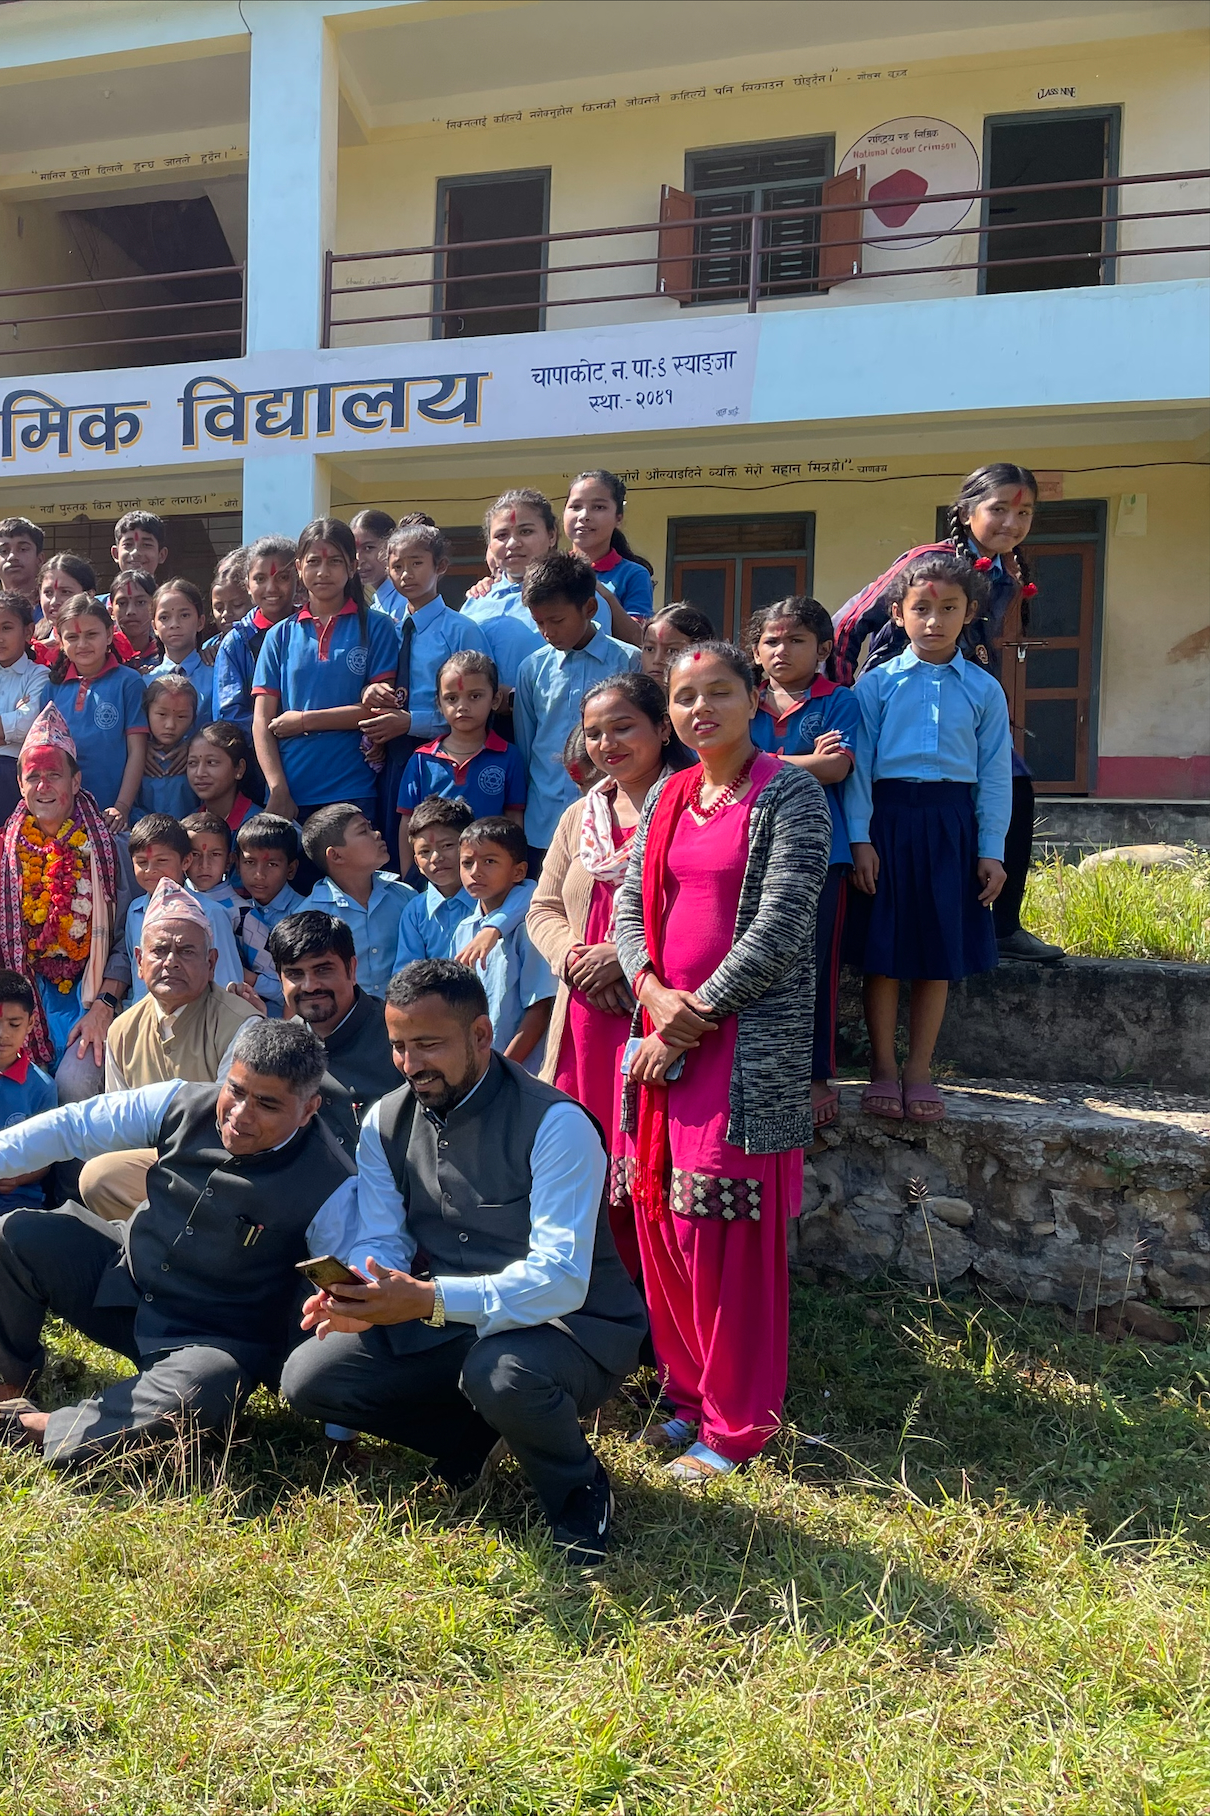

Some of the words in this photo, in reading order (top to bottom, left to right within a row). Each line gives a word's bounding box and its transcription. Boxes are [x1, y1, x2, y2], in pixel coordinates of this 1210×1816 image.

[714, 84, 734, 96] पनि
[853, 148, 888, 159] National
[891, 145, 917, 156] Colour
[918, 142, 957, 153] Crimson
[177, 372, 493, 450] विद्यालय
[744, 463, 764, 478] मेरो
[93, 499, 112, 511] किन
